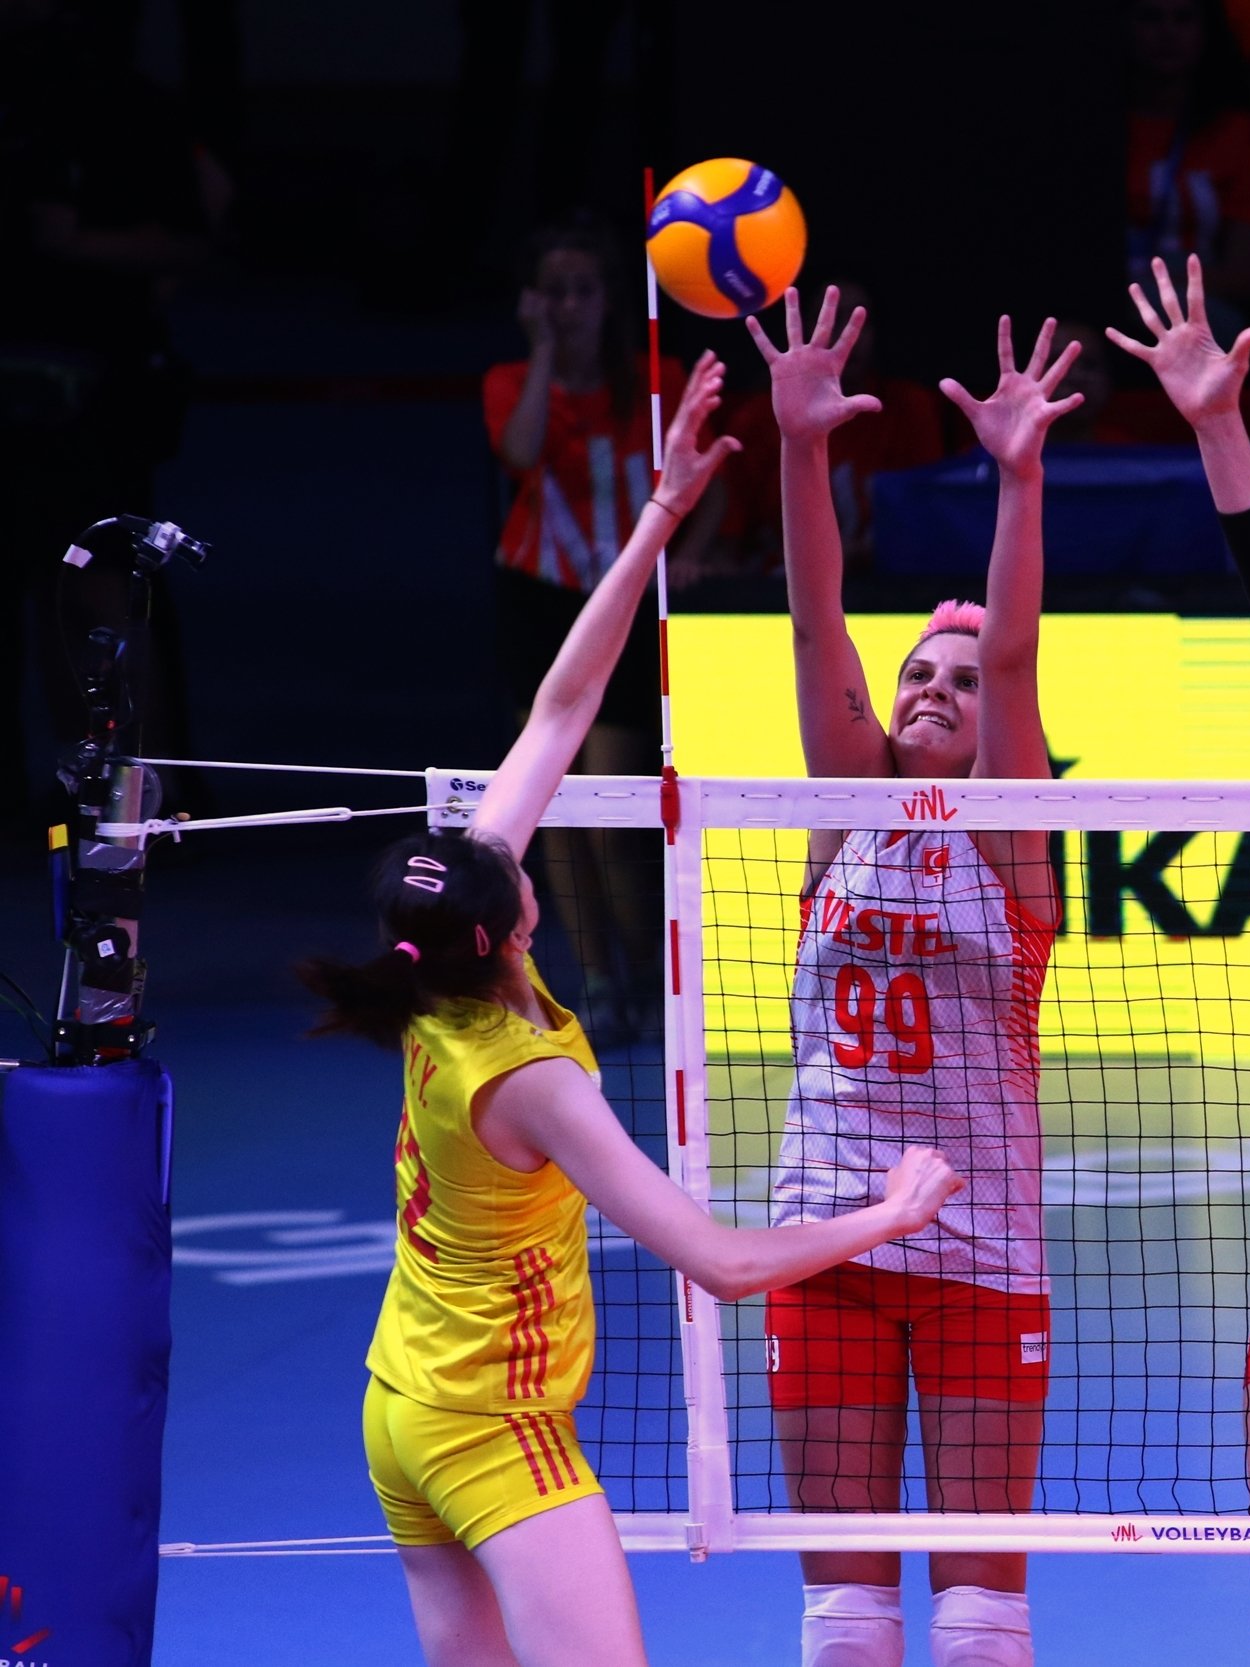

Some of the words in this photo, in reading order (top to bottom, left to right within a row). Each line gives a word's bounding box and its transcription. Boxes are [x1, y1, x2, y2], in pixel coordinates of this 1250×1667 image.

[901, 785, 958, 821] VNL
[820, 889, 958, 958] VESTEL
[834, 963, 934, 1075] 99
